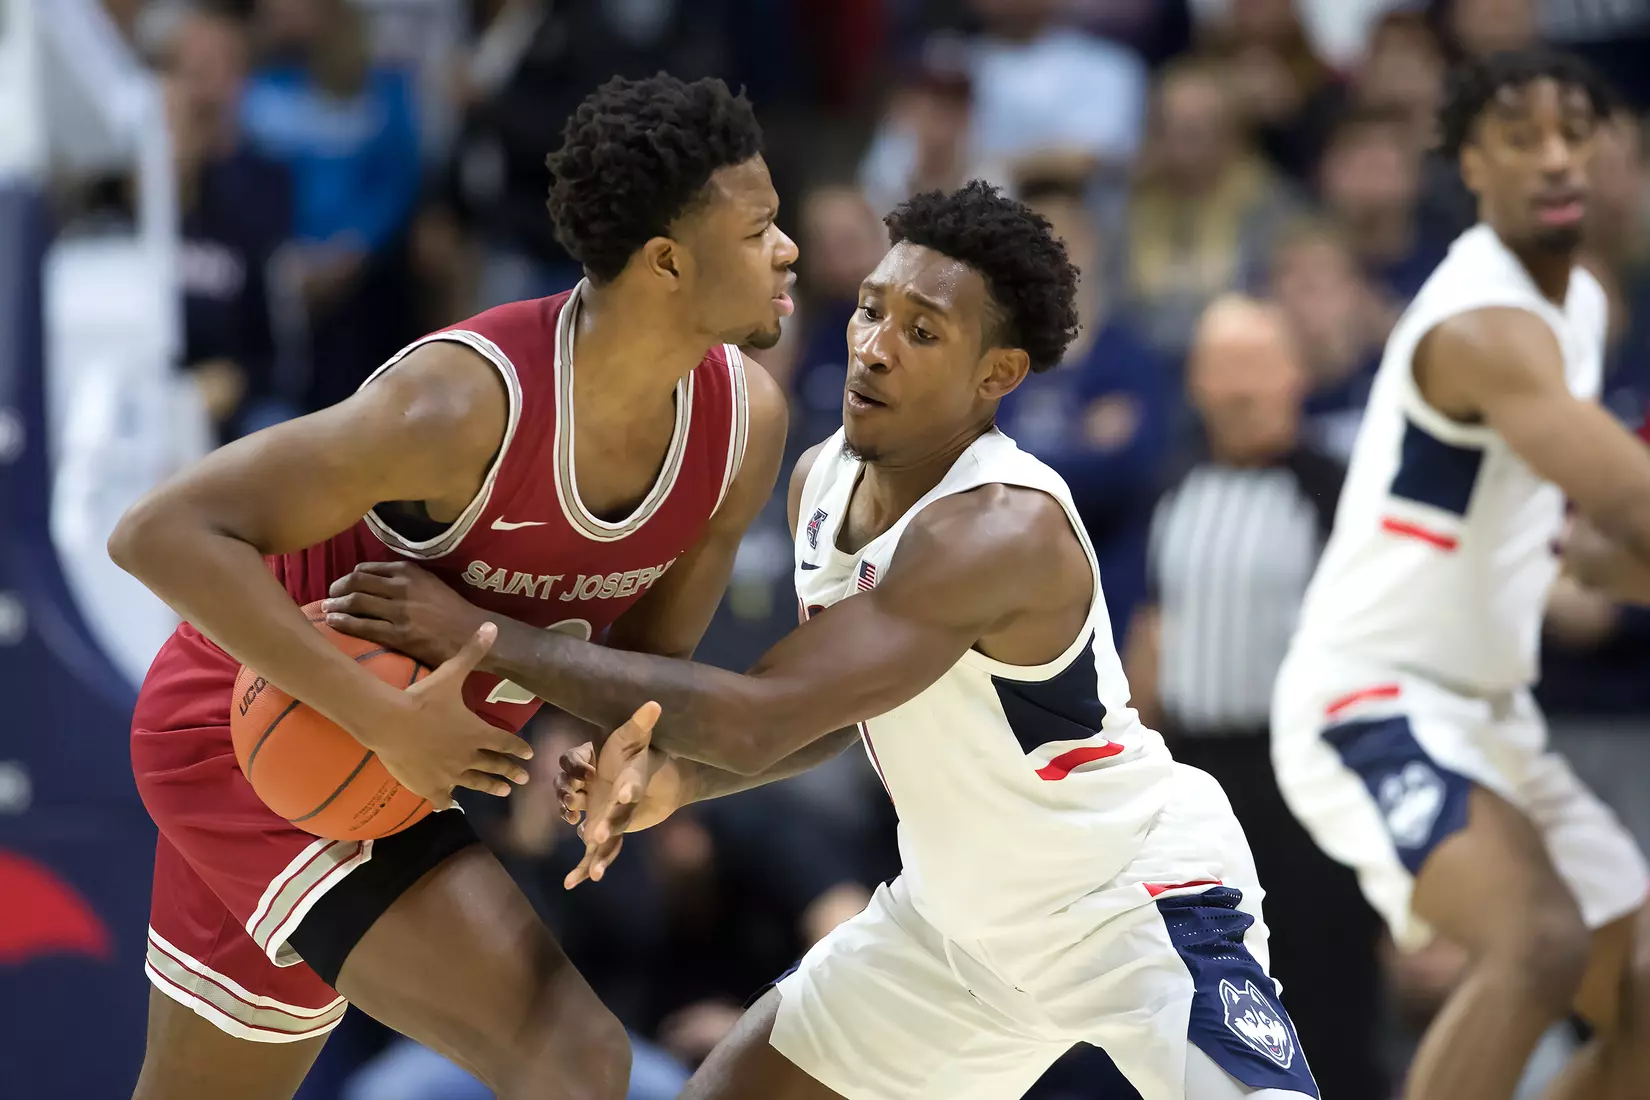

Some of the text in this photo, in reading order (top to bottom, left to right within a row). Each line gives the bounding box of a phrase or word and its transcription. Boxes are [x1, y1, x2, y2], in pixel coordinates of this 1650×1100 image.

[461, 556, 678, 601] SAINT JOSEPH
[239, 676, 269, 717] UCO
